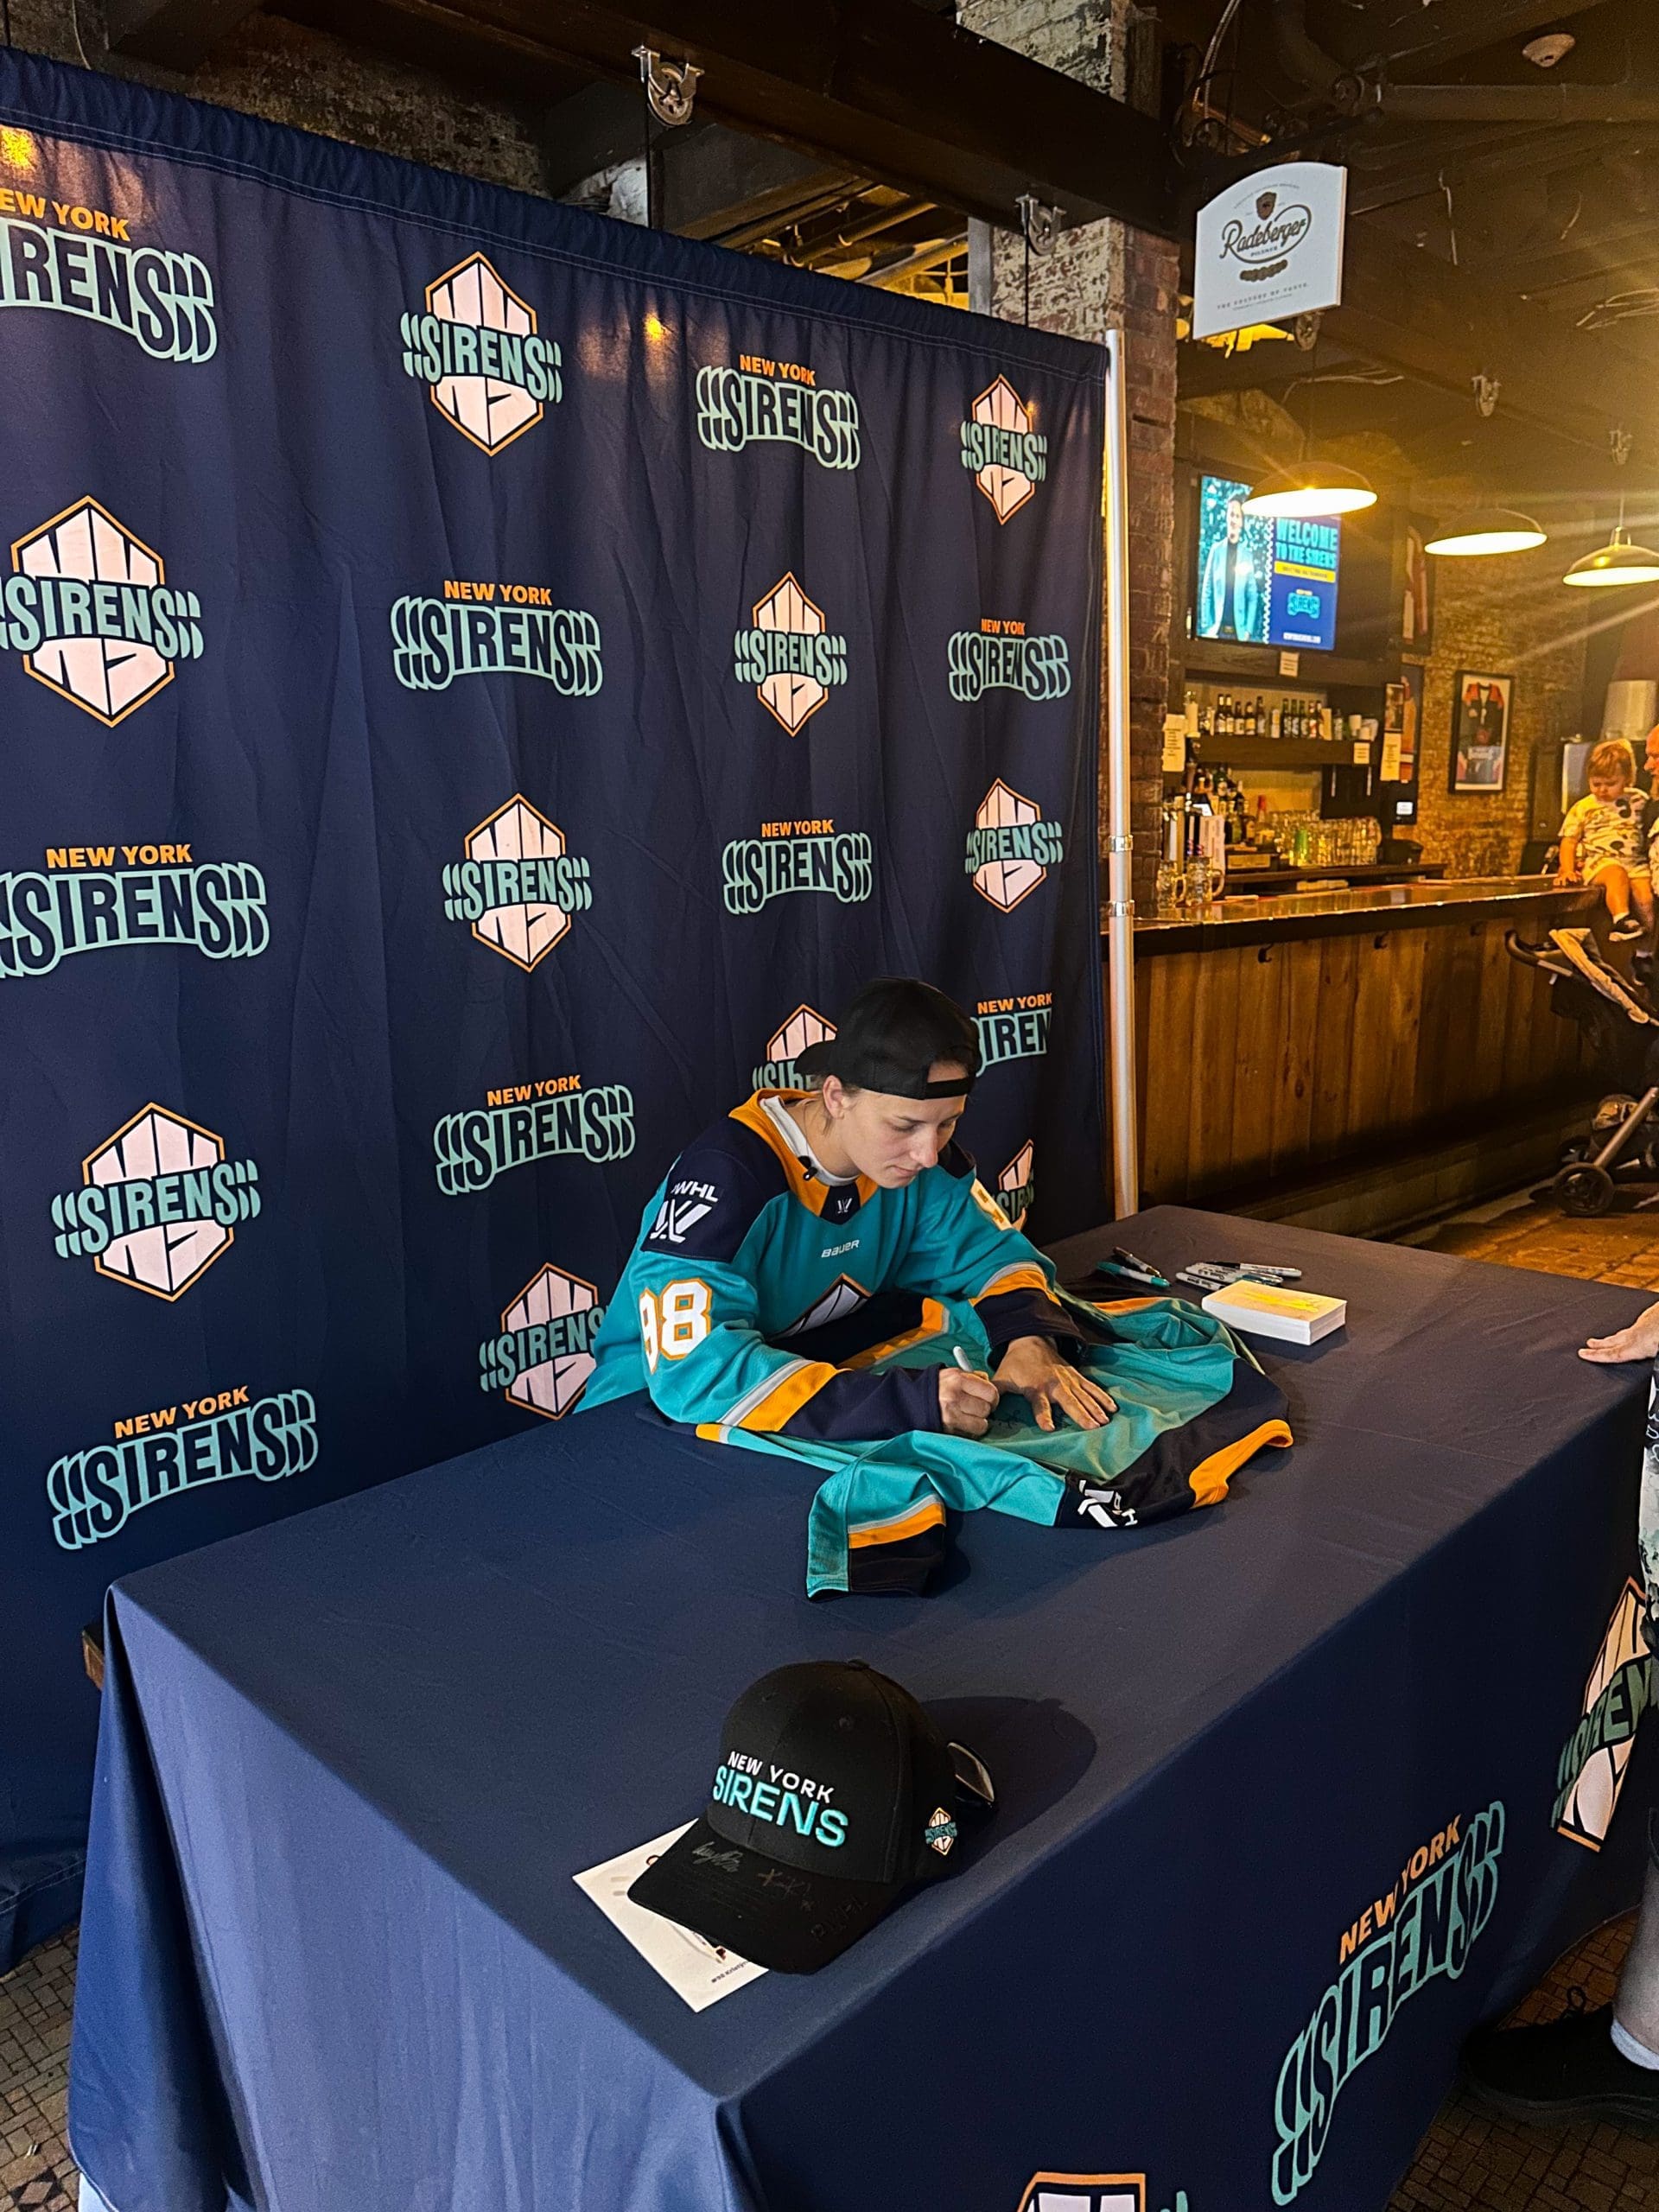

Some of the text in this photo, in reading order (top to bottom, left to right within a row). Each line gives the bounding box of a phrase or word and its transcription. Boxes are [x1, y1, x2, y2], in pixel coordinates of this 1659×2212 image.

[0, 188, 130, 241] EW YORK
[1219, 219, 1307, 259] Radeberger
[0, 218, 218, 363] RENS
[401, 313, 562, 403] SIRENS
[741, 355, 815, 385] NEW YORK
[696, 365, 860, 469] SIRENS
[962, 421, 1047, 481] SIRENS
[1276, 518, 1338, 551] WELCOME
[0, 576, 203, 659] SIRENS
[444, 581, 552, 605] NEW YORK
[981, 619, 1001, 633] NEW
[391, 596, 603, 696] SIRENS
[734, 630, 848, 686] SIRENS
[949, 632, 1071, 702] SIRENS
[46, 843, 193, 868] NEW YORK
[761, 819, 834, 837] NEW YORK
[965, 822, 1064, 875] SIRENS
[442, 857, 592, 922] SIRENS
[722, 832, 872, 914] SIRENS
[0, 862, 270, 978] SIRENS
[977, 998, 1014, 1014] NEW
[969, 1007, 1052, 1077] IREN
[486, 1075, 581, 1107] NEW YORK
[434, 1085, 636, 1195] SIRENS
[51, 1159, 262, 1259] SIRENS
[639, 1278, 712, 1373] 98
[114, 1384, 249, 1439] NEW YORK
[47, 1389, 319, 1550] SIRENS
[713, 1764, 849, 1847] SIRENS
[728, 1751, 835, 1804] NEW YORK
[1339, 1814, 1461, 1965] NEW YORK
[1271, 1800, 1505, 2206] SIRENS
